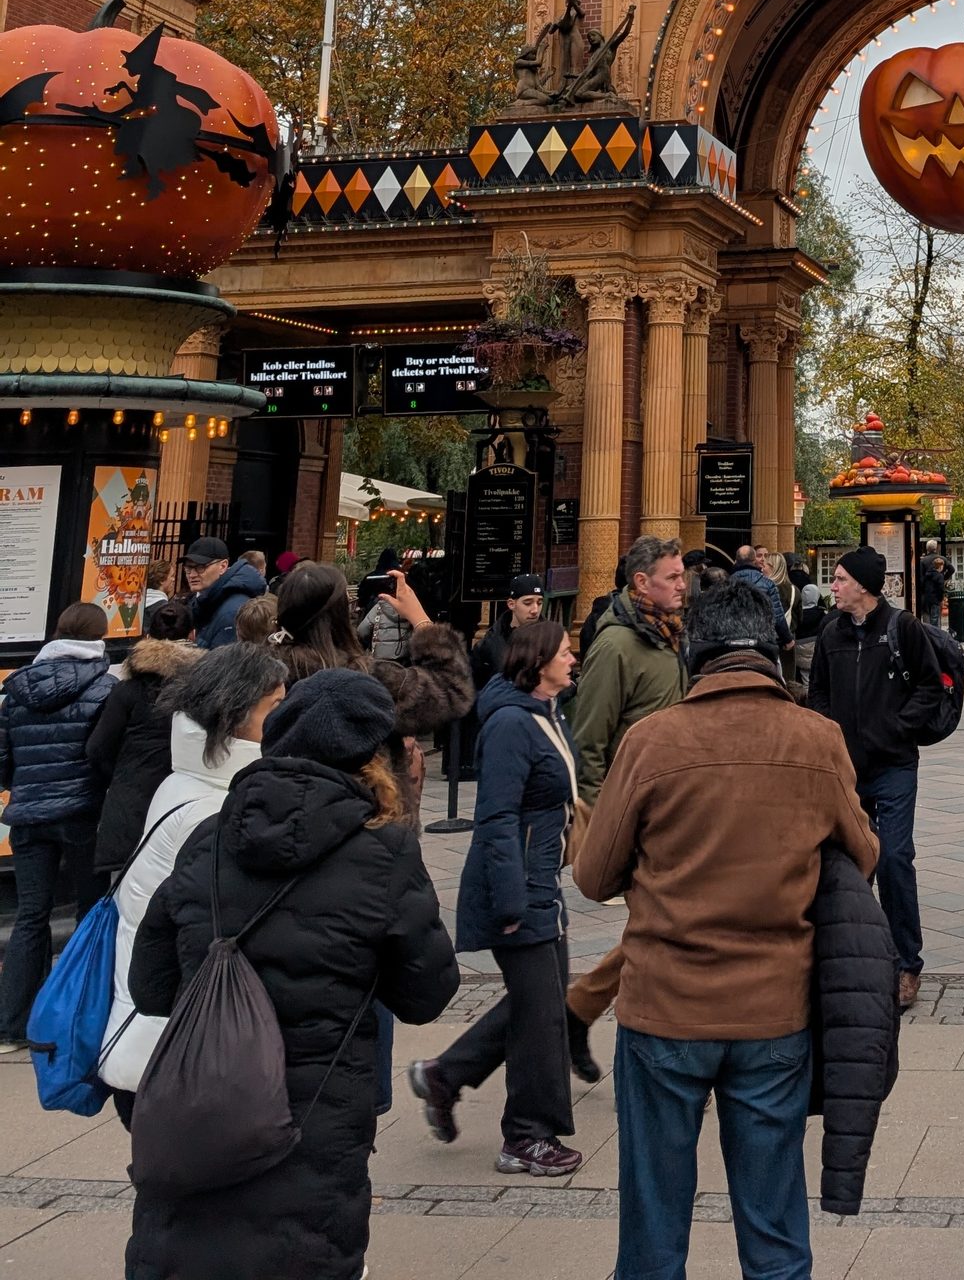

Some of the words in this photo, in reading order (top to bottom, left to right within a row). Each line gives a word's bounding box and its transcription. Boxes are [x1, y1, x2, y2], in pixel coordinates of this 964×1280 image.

[283, 361, 305, 370] eller
[406, 357, 424, 367] Buy
[439, 355, 475, 365] redeem
[251, 372, 275, 382] billet
[277, 372, 299, 381] eller
[300, 370, 347, 381] Tivolikort
[392, 368, 424, 378] tickets
[438, 366, 465, 376] Tivoli
[267, 404, 277, 413] 10
[322, 403, 328, 412] 9
[410, 401, 416, 409] 8
[489, 467, 515, 475] TIVOLI
[0, 486, 44, 502] RAM
